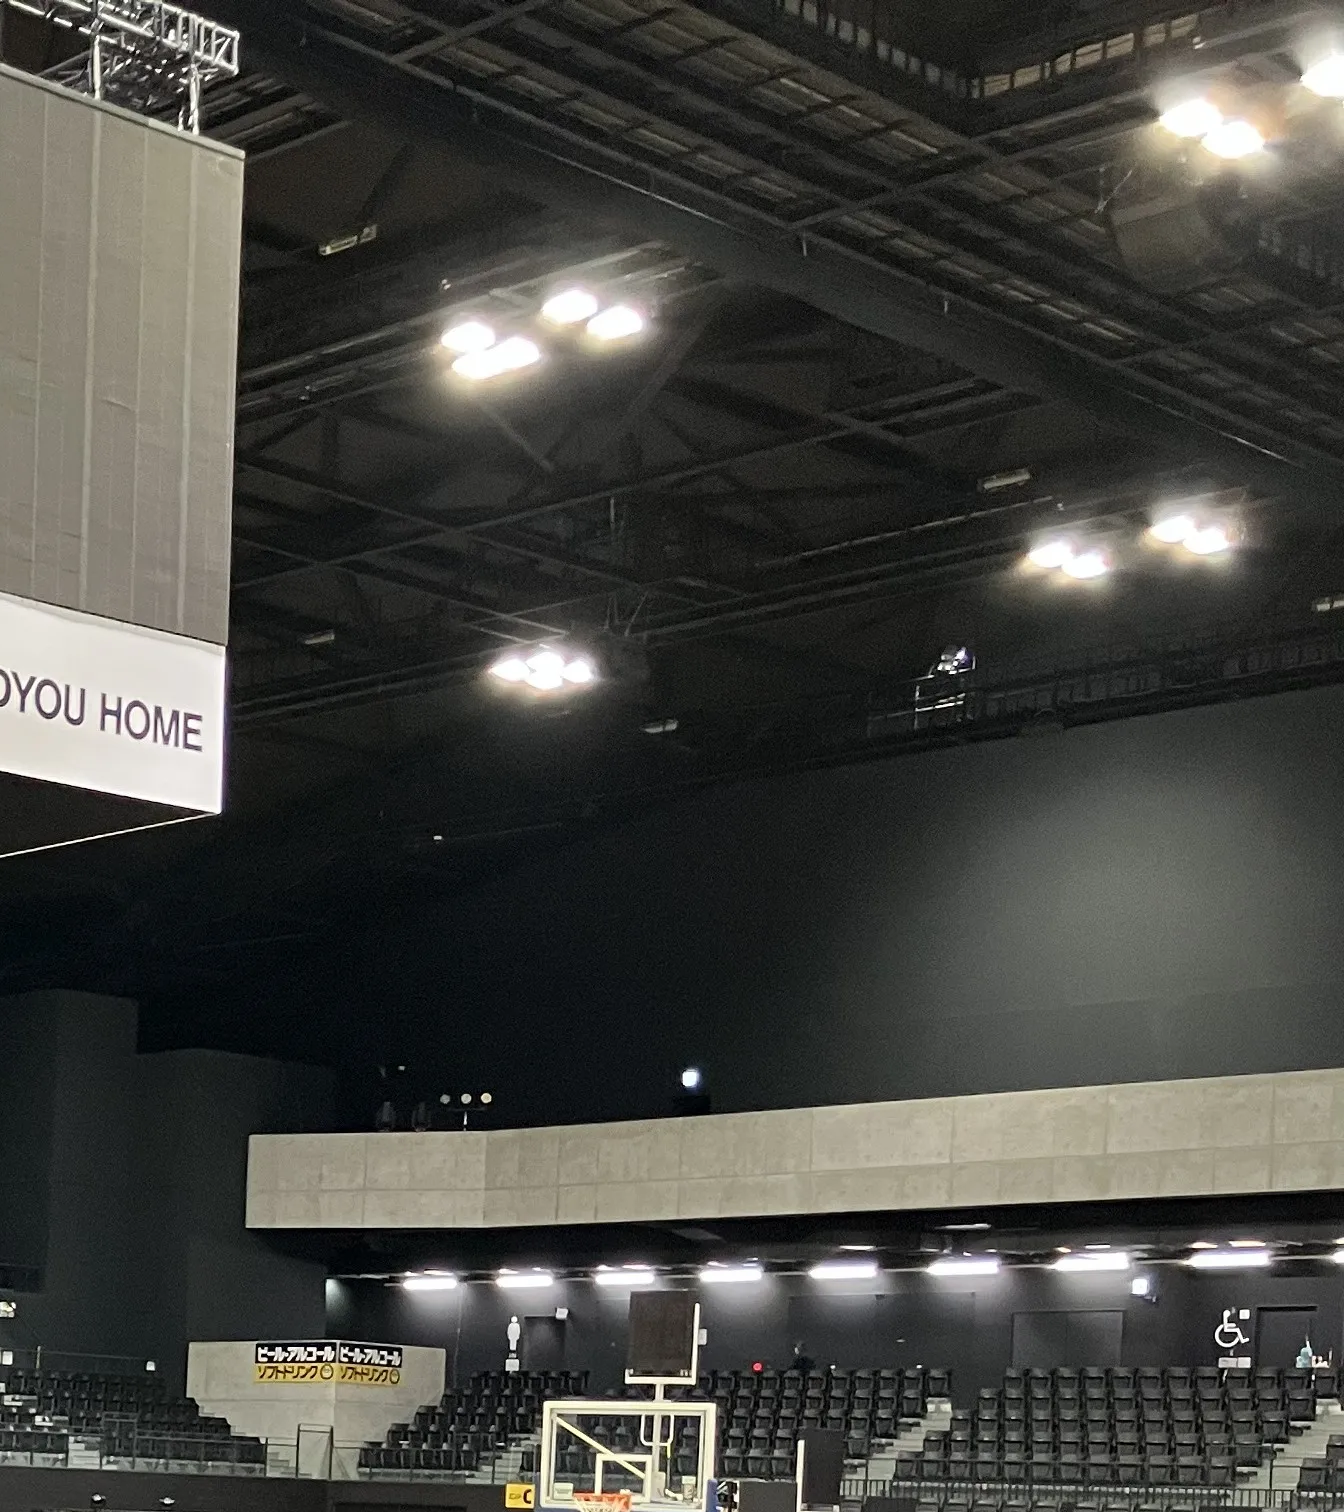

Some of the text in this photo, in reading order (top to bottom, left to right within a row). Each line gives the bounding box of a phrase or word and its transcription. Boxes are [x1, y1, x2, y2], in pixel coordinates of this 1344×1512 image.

[99, 698, 205, 755] HOME
[258, 1366, 318, 1379] ソフトドリンク
[341, 1366, 389, 1382] ソフトドリンク
